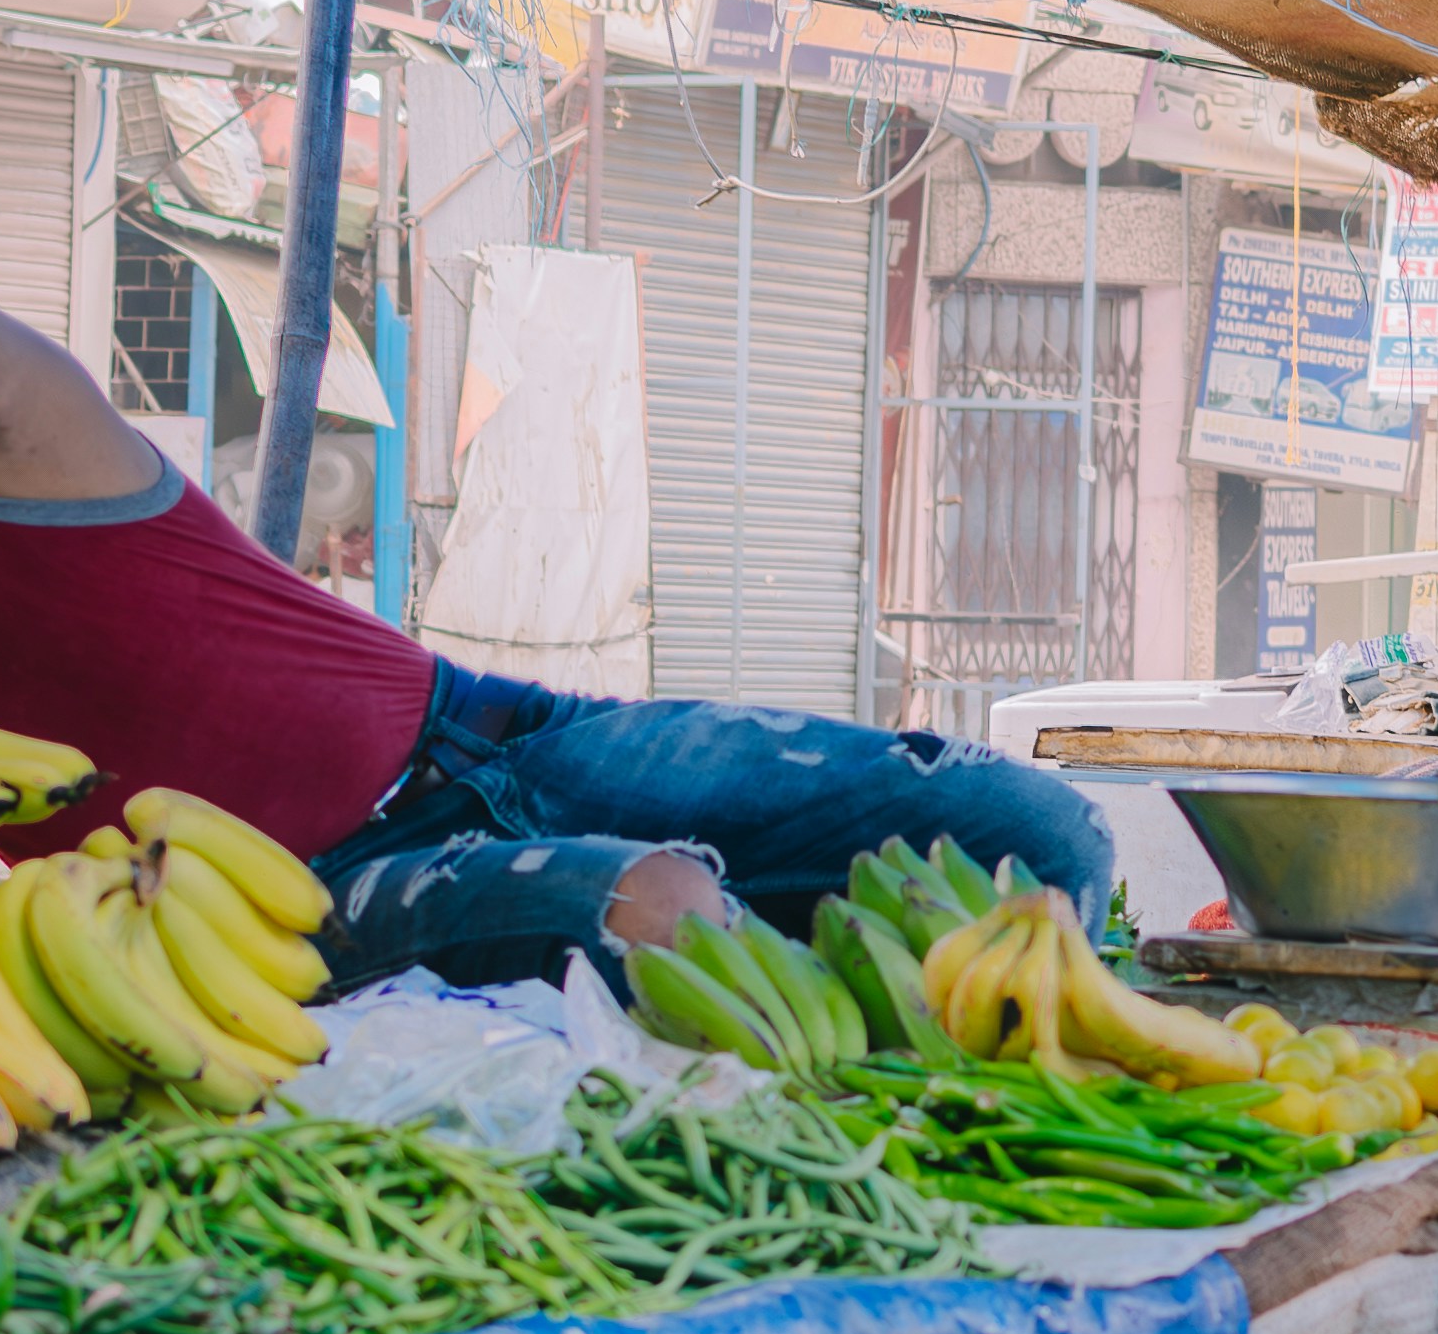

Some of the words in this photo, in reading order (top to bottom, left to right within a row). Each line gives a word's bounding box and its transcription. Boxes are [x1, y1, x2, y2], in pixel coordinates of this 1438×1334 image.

[1218, 302, 1250, 320] TAJ
[1220, 286, 1268, 307] DELHI
[1305, 300, 1354, 320] DELHI
[1263, 489, 1316, 529] SOUTHERN
[1263, 533, 1316, 574] EXPRESS
[1265, 579, 1312, 619] TRAVELS
